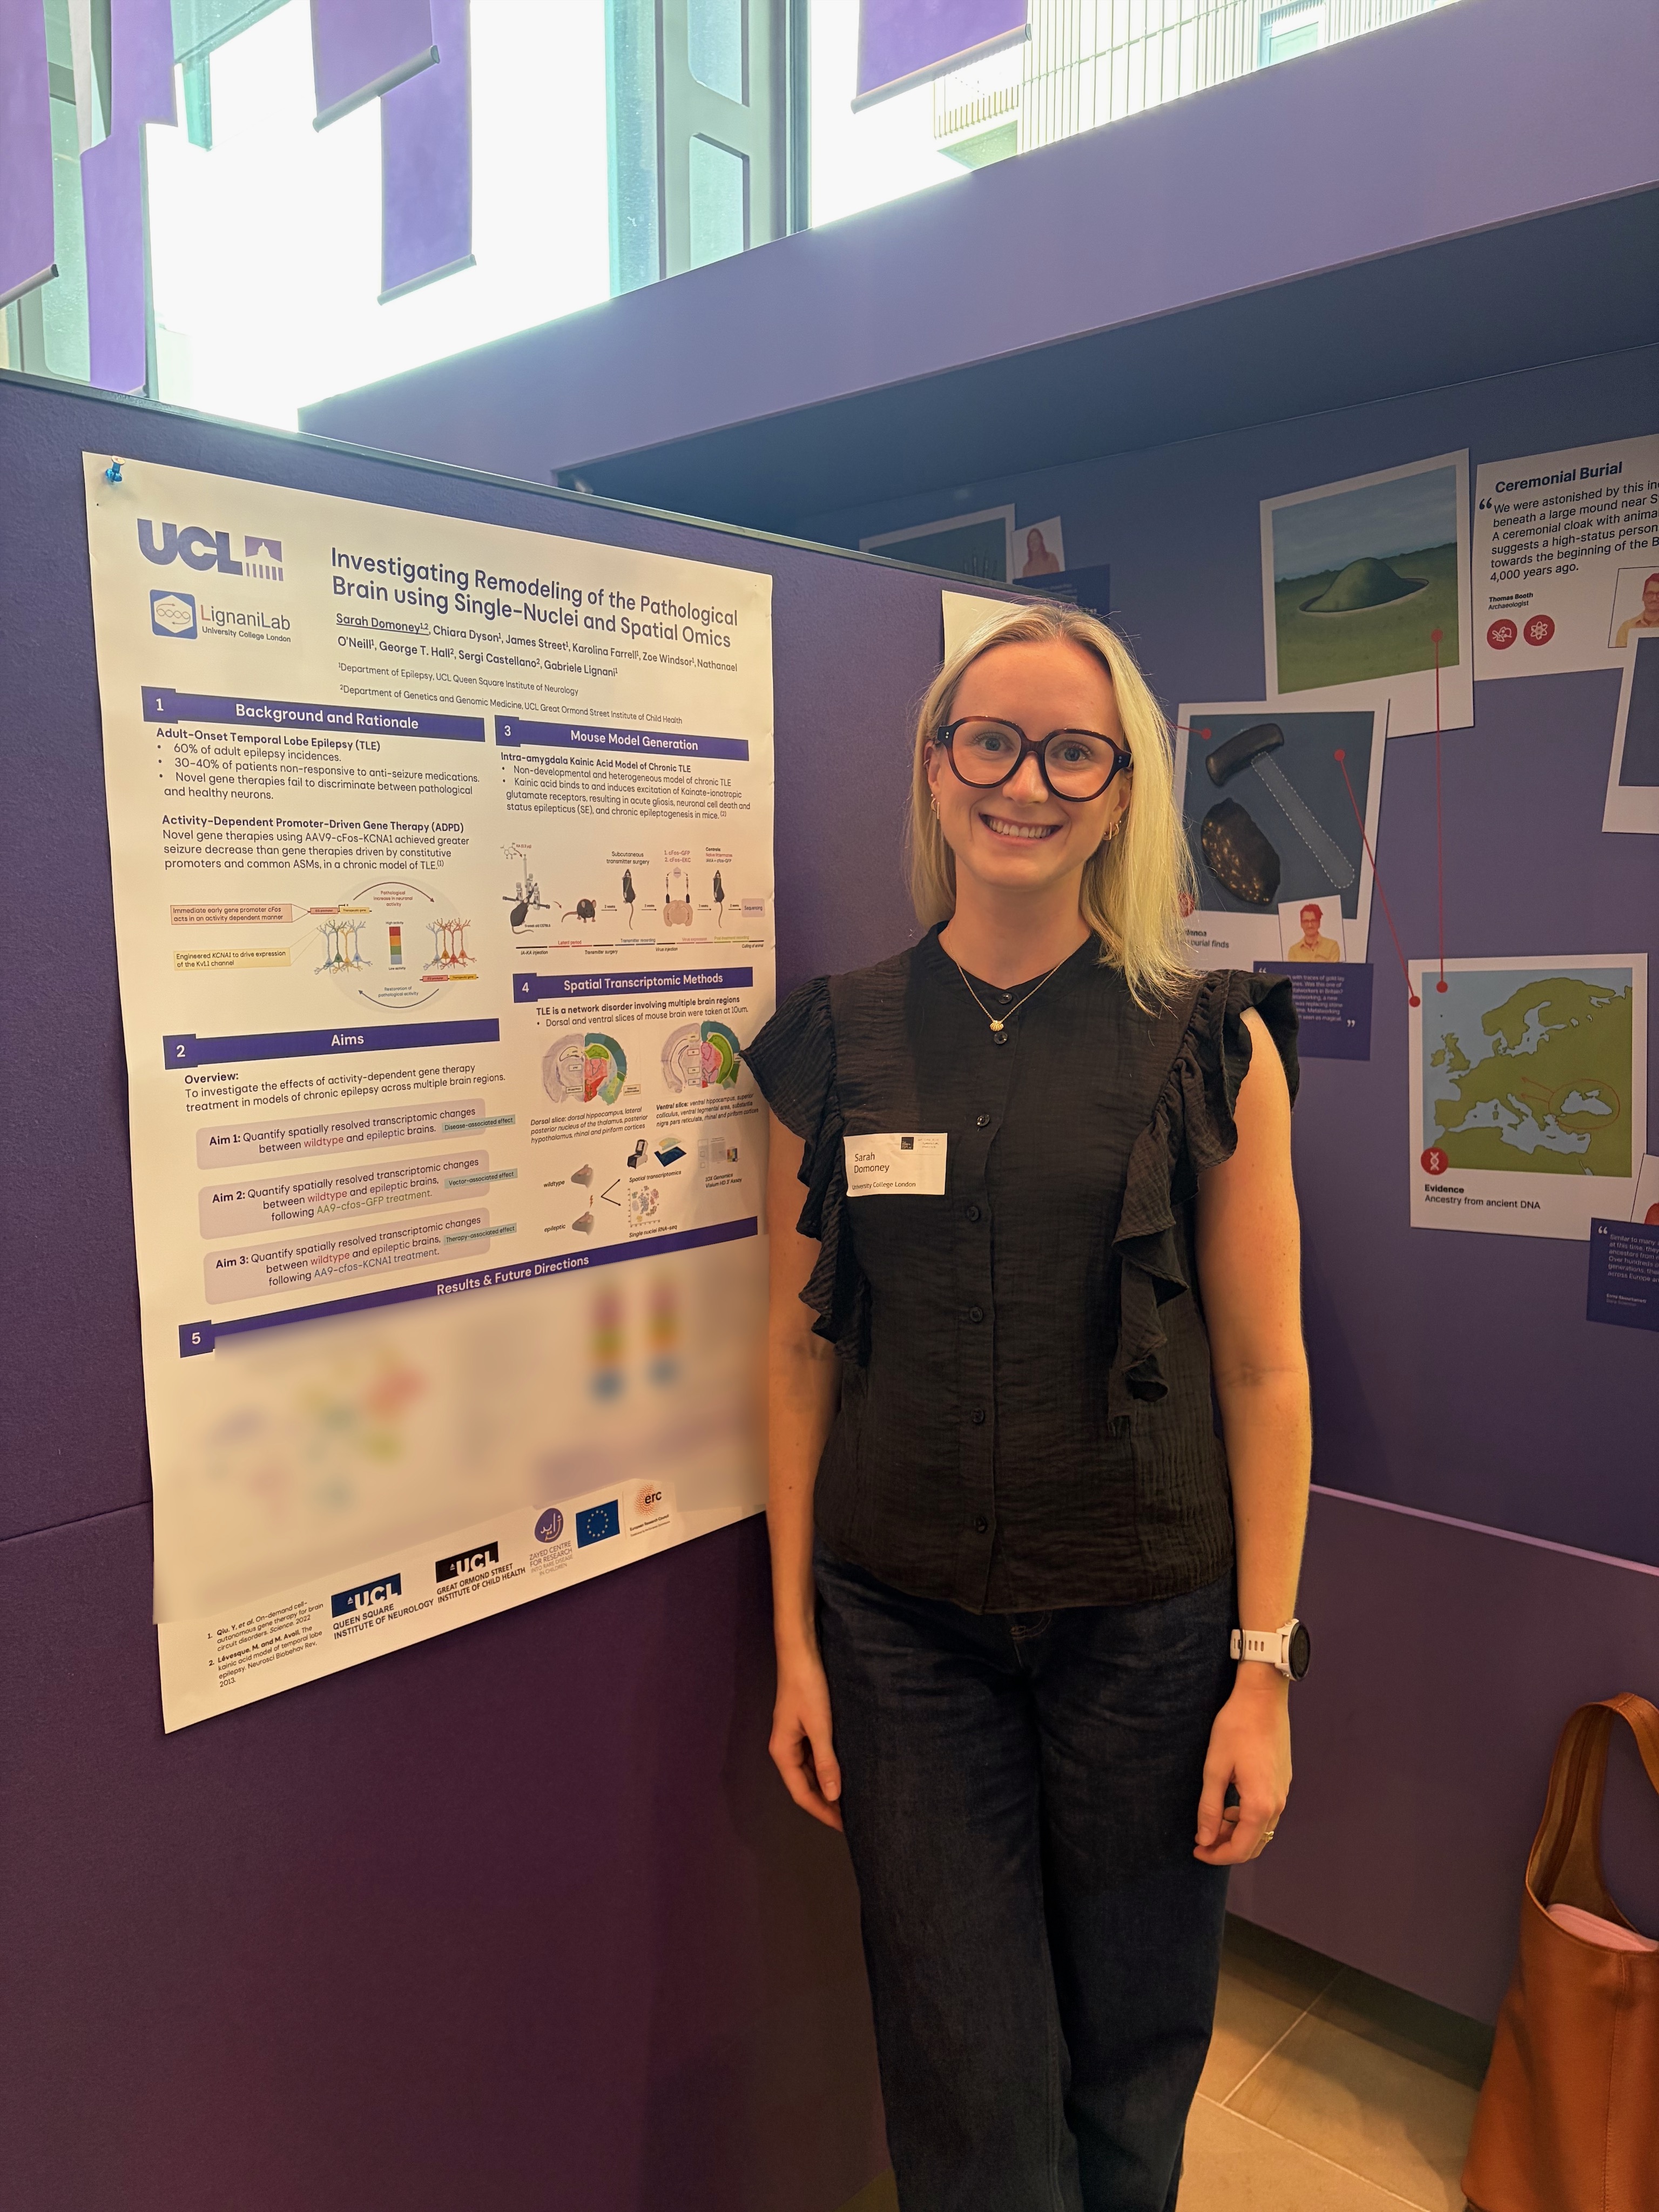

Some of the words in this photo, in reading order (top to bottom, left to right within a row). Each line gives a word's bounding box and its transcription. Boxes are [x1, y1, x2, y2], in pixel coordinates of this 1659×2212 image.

[1495, 469, 1576, 493] Ceremonial
[1580, 461, 1622, 480] Burial
[1494, 504, 1509, 514] We
[1514, 501, 1539, 510] were
[1542, 488, 1602, 506] astonished
[1606, 487, 1619, 497] by
[1623, 482, 1643, 493] this
[1648, 480, 1659, 490] in
[1494, 513, 1535, 527] beneath
[1549, 509, 1576, 519] large
[1580, 500, 1617, 514] mound
[1622, 497, 1647, 508] near
[1492, 532, 1499, 541] A
[1503, 523, 1560, 539] ceremonial
[1564, 518, 1593, 530] cloak
[1597, 514, 1620, 525] with
[137, 518, 243, 576] UCL
[1492, 541, 1539, 555] suggests
[1553, 531, 1615, 547] high-status
[1619, 525, 1657, 539] person
[1491, 555, 1532, 568] towards
[1536, 552, 1553, 562] the
[1557, 545, 1610, 559] beginning
[1615, 541, 1626, 551] of
[1630, 539, 1648, 549] the
[1491, 569, 1520, 583] 4,000
[1523, 567, 1552, 579] years
[1556, 564, 1578, 574] ago.
[332, 548, 468, 590] Investigating
[476, 570, 582, 607] Remodeling
[588, 589, 604, 605] of
[609, 591, 635, 610] the
[641, 596, 737, 626] Pathological
[333, 576, 388, 601] Brain
[395, 587, 448, 614] using
[455, 593, 578, 626] Single-Nuclei
[584, 615, 616, 632] and
[621, 617, 677, 640] Spatial
[683, 626, 730, 648] Omics
[1488, 601, 1528, 610] Archaeologist
[201, 605, 290, 630] LignaniLab
[203, 626, 236, 638] University
[239, 631, 264, 640] College
[267, 633, 291, 642] London
[156, 698, 164, 711] 1
[236, 704, 323, 722] Background
[327, 712, 353, 724] and
[356, 713, 418, 729] Rationale
[157, 728, 228, 741] Adult-Onset
[230, 733, 281, 745] Temporal
[284, 736, 308, 746] Lobe
[312, 738, 353, 751] Epilepsy
[356, 739, 380, 752] (TLE)
[505, 725, 511, 736] 3
[571, 730, 605, 743] Mouse
[609, 733, 639, 745] Model
[643, 736, 698, 750] Generation
[174, 744, 198, 753] 60%
[201, 745, 211, 754] of
[214, 746, 241, 756] adult
[244, 748, 285, 760] epilepsy
[288, 750, 341, 761] incidences.
[501, 752, 568, 765] Intra-amygdala
[570, 757, 594, 766] Kainic
[596, 759, 613, 767] Acid
[616, 760, 637, 769] Model
[649, 763, 677, 772] Chronic
[163, 815, 273, 828] Activity-Dependent
[276, 818, 360, 828] Promoter-Driven
[363, 821, 388, 830] Gene
[390, 821, 429, 833] Therapy
[432, 822, 463, 833] (ADPD)
[522, 982, 529, 992] 4
[564, 979, 602, 993] Spatial
[604, 975, 680, 989] Transcriptomic
[684, 973, 723, 984] Methods
[536, 1007, 550, 1015] TLE
[568, 1004, 599, 1013] network
[602, 1003, 632, 1011] disorder
[635, 1001, 666, 1009] involving
[669, 999, 696, 1008] multiple
[717, 996, 739, 1005] regions
[332, 1034, 364, 1046] Aims
[177, 1045, 185, 1057] 2
[185, 1073, 238, 1084] Overview:
[210, 1136, 230, 1145] Aim
[233, 1135, 240, 1143] 1:
[244, 1129, 285, 1142] Quantify
[289, 1124, 328, 1138] spatially
[332, 1119, 370, 1131] resolved
[373, 1112, 437, 1126] transcriptomic
[440, 1109, 475, 1118] changes
[445, 1119, 496, 1130] Disease-associated
[259, 1142, 301, 1153] between
[304, 1137, 343, 1147] wildtype
[347, 1132, 363, 1142] and
[367, 1128, 404, 1141] epileptic
[408, 1125, 436, 1135] brains.
[855, 1152, 875, 1162] Sarah
[1425, 1184, 1464, 1193] Evidence
[1425, 1195, 1461, 1205] Ancestry
[1465, 1197, 1483, 1205] from
[1486, 1199, 1517, 1208] ancient
[1521, 1201, 1540, 1209] DNA
[437, 1279, 480, 1295] Results
[483, 1275, 492, 1285] &
[496, 1269, 531, 1283] Future
[535, 1257, 589, 1274] Directions
[192, 1332, 200, 1344] 5
[645, 1492, 662, 1504] erc
[530, 1549, 548, 1560] ZAYED
[549, 1541, 571, 1553] CENTRE
[530, 1559, 542, 1567] FOR
[543, 1548, 572, 1562] RESEARCH
[456, 1551, 498, 1573] UCL
[437, 1582, 457, 1594] GREAT
[460, 1572, 489, 1587] ORMOND
[491, 1563, 512, 1576] STREET
[438, 1587, 470, 1603] INSTITUTE
[472, 1583, 480, 1591] OF
[482, 1576, 500, 1587] CHILD
[502, 1567, 525, 1581] HEALTH
[354, 1583, 400, 1608] UCL
[333, 1615, 360, 1630] QUEEN
[363, 1603, 394, 1620] SQUARE
[334, 1620, 374, 1640] INSTITUTE
[376, 1616, 385, 1624] OF
[388, 1599, 434, 1621] NEUROLOGY
